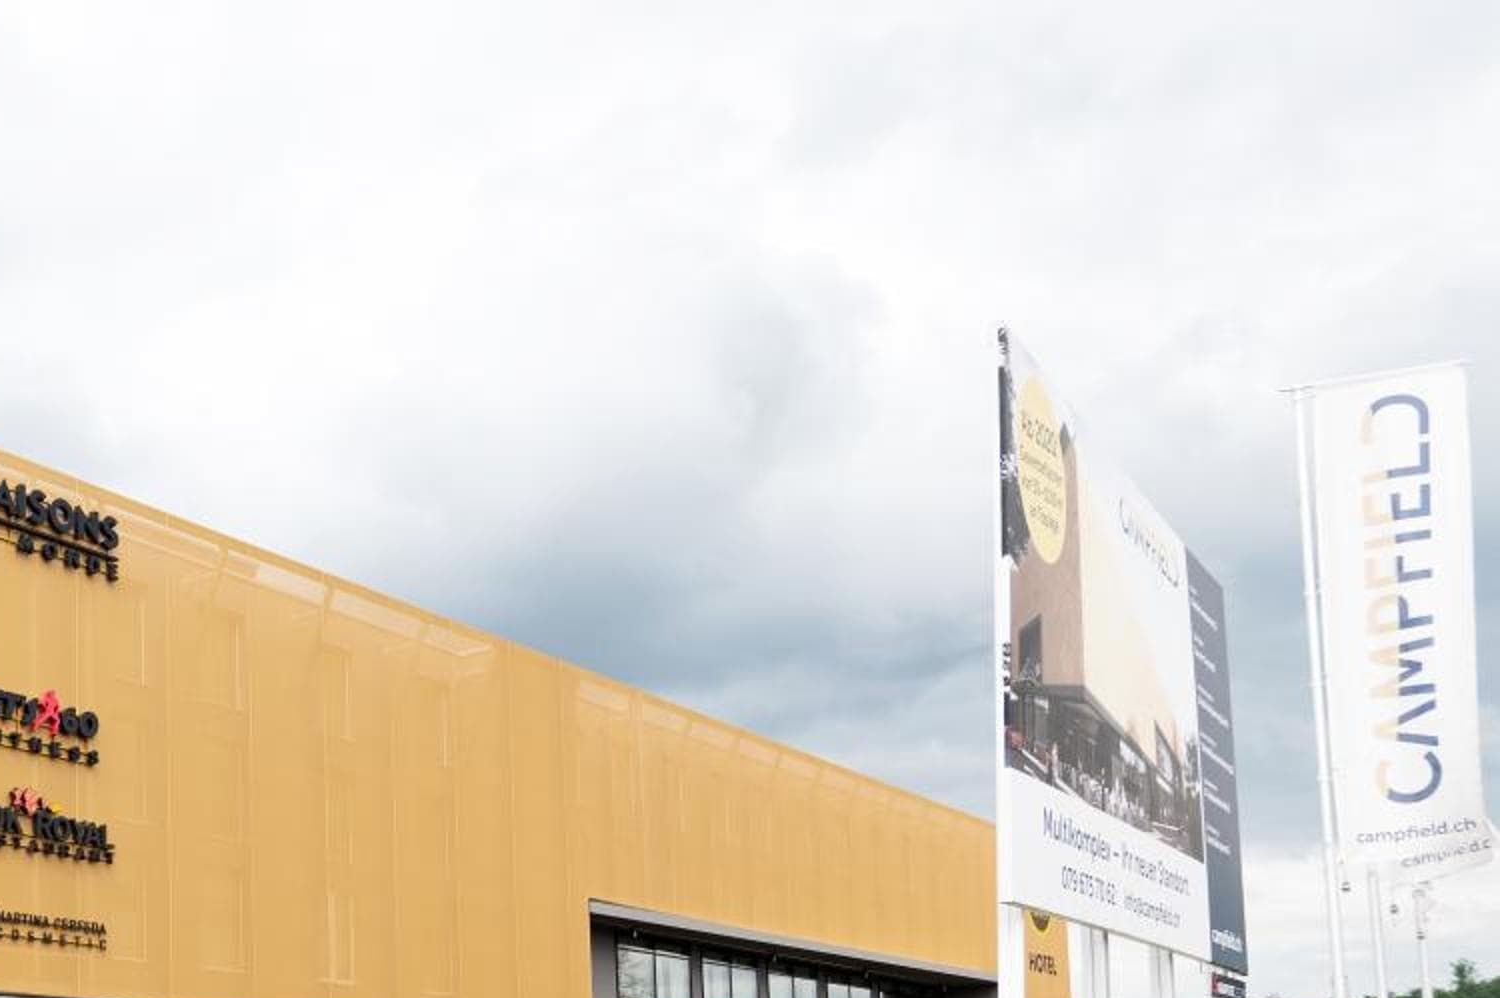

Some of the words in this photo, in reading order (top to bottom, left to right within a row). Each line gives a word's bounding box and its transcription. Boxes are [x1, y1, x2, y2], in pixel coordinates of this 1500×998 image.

[17, 533, 119, 582] MONDE
[1359, 393, 1443, 804] CAMPFIELD
[60, 707, 99, 738] GO
[33, 809, 114, 849] ROYAL
[1356, 817, 1477, 844] campfield.ch
[1029, 952, 1057, 976] HOTEL
